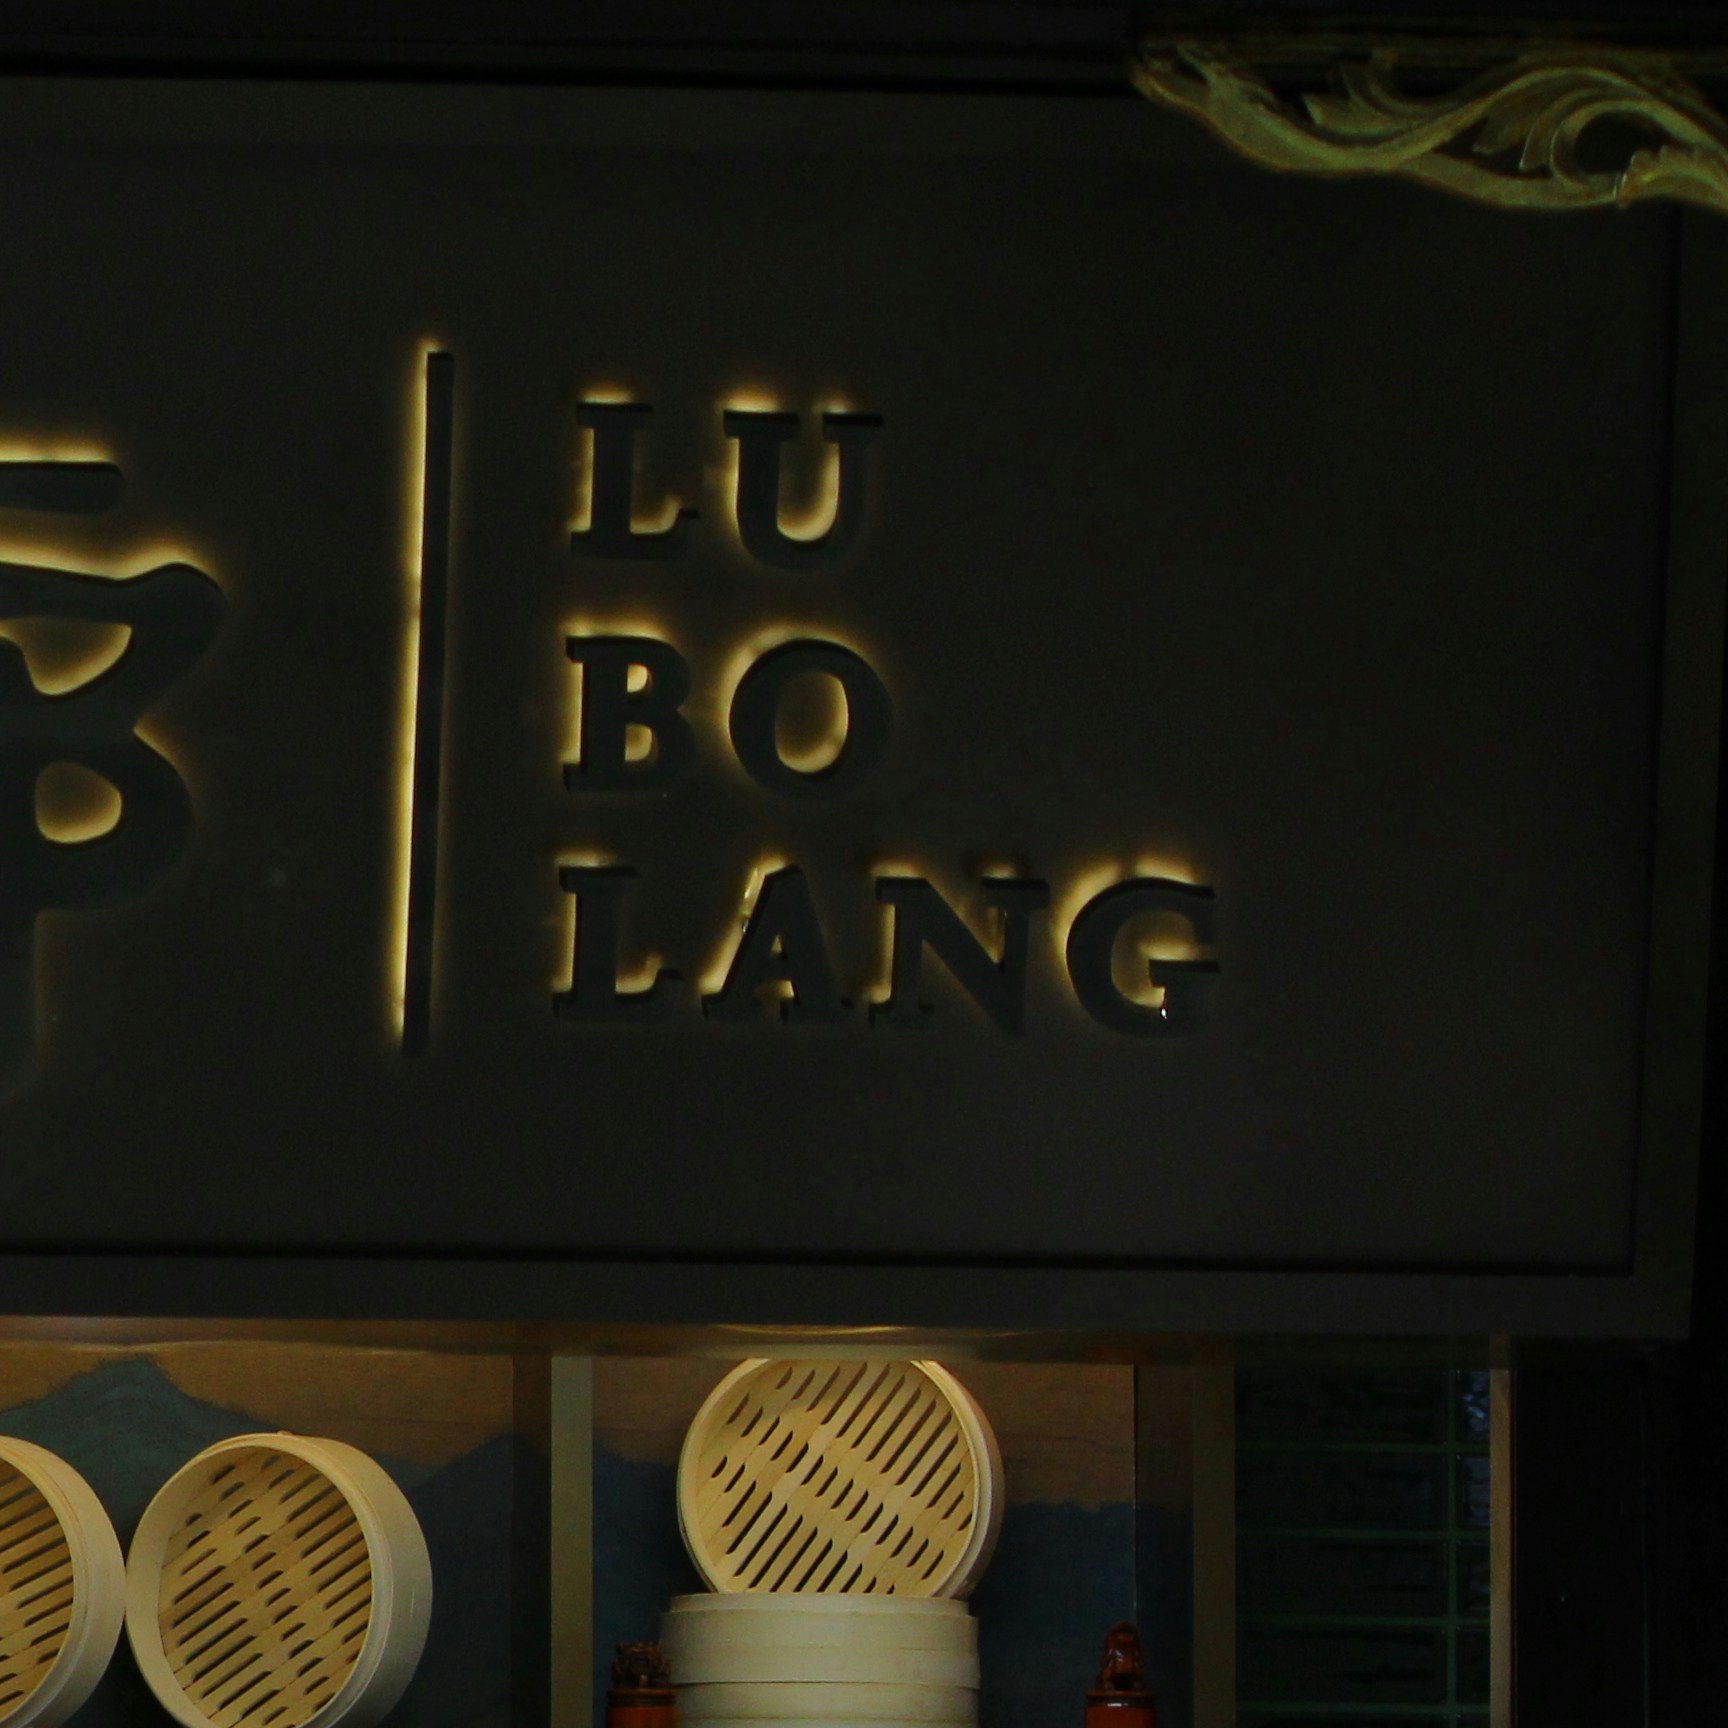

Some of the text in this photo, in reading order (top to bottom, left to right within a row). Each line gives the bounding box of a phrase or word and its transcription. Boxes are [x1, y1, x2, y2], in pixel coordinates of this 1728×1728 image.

[570, 392, 886, 572] LU
[554, 622, 894, 800] BO
[548, 855, 1224, 1040] LANG
